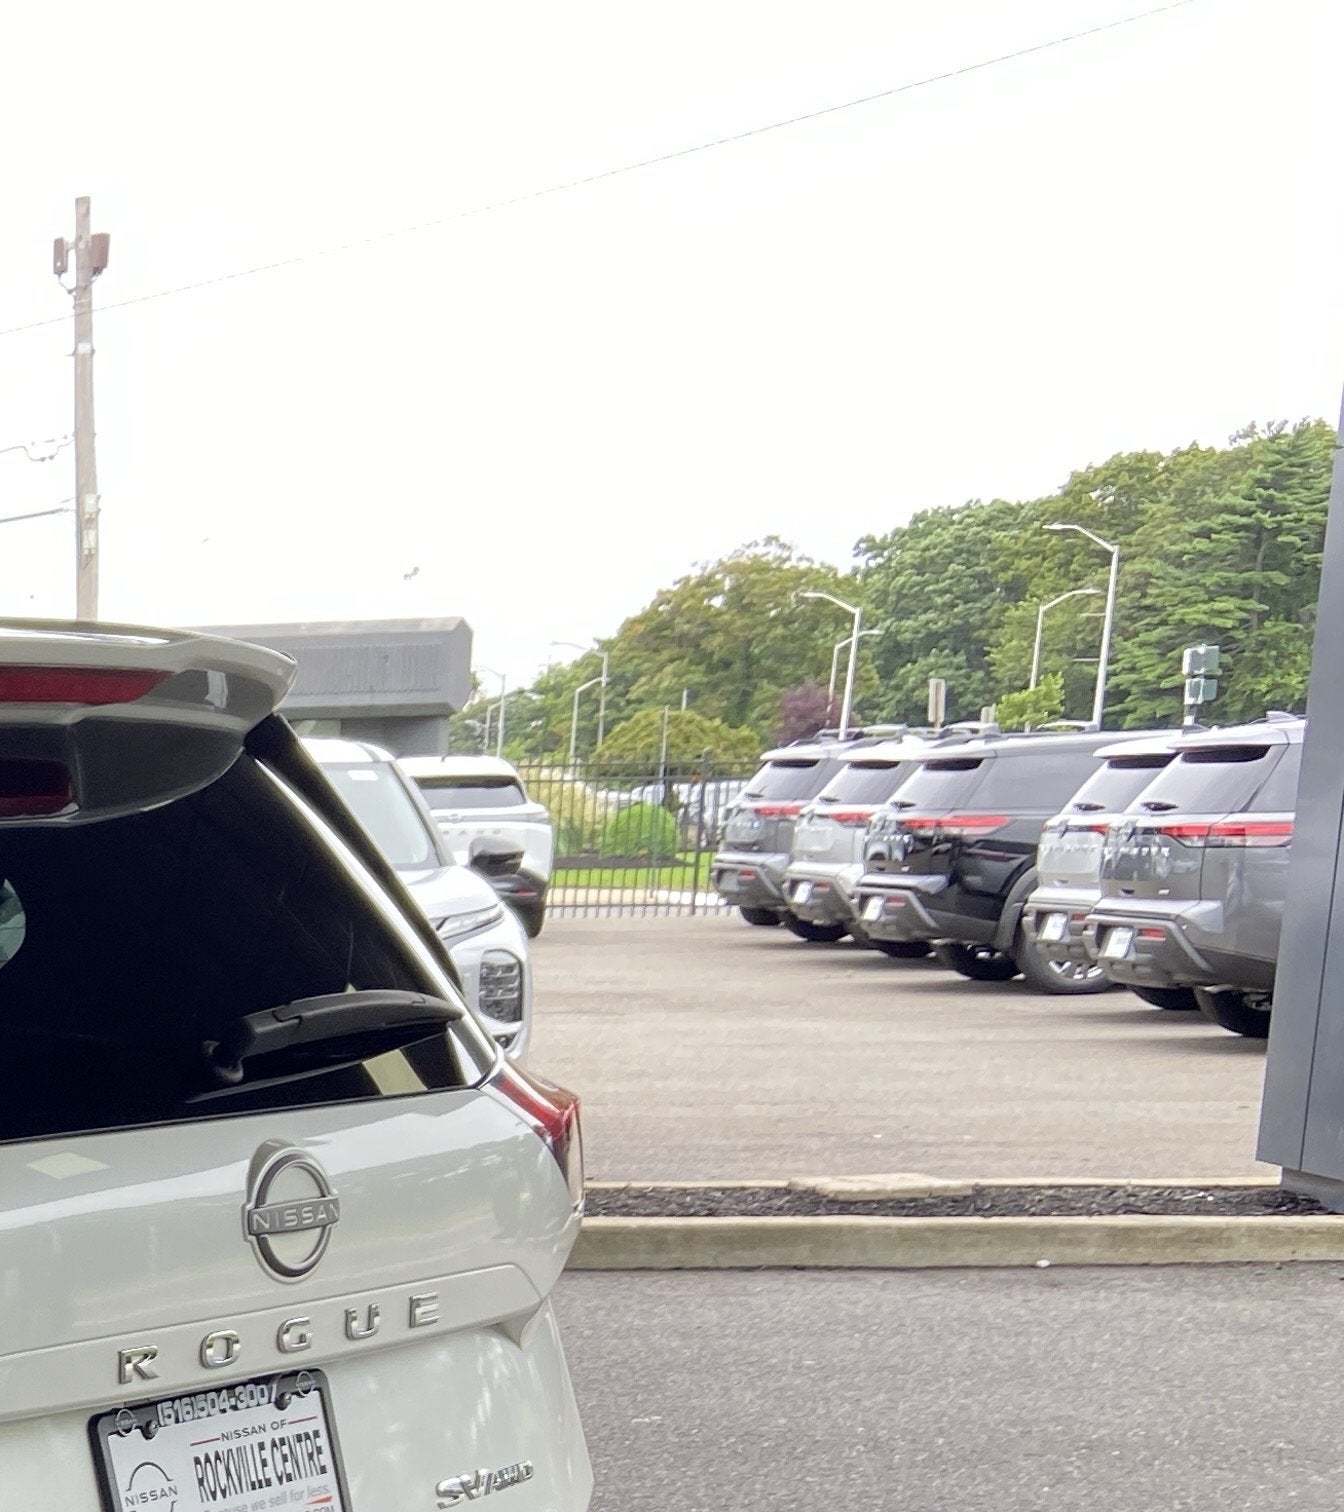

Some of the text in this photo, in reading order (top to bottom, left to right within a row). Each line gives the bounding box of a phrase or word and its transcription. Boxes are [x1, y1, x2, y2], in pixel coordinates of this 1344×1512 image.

[252, 1202, 339, 1231] NISSAN
[118, 1292, 441, 1385] ROGUE
[220, 1418, 288, 1443] NISSAN OF
[193, 1429, 328, 1503] ROCKVILLE CENTRE
[124, 1484, 179, 1508] NISSAN
[251, 1500, 267, 1512] we
[269, 1493, 288, 1508] sell
[289, 1487, 305, 1503] for
